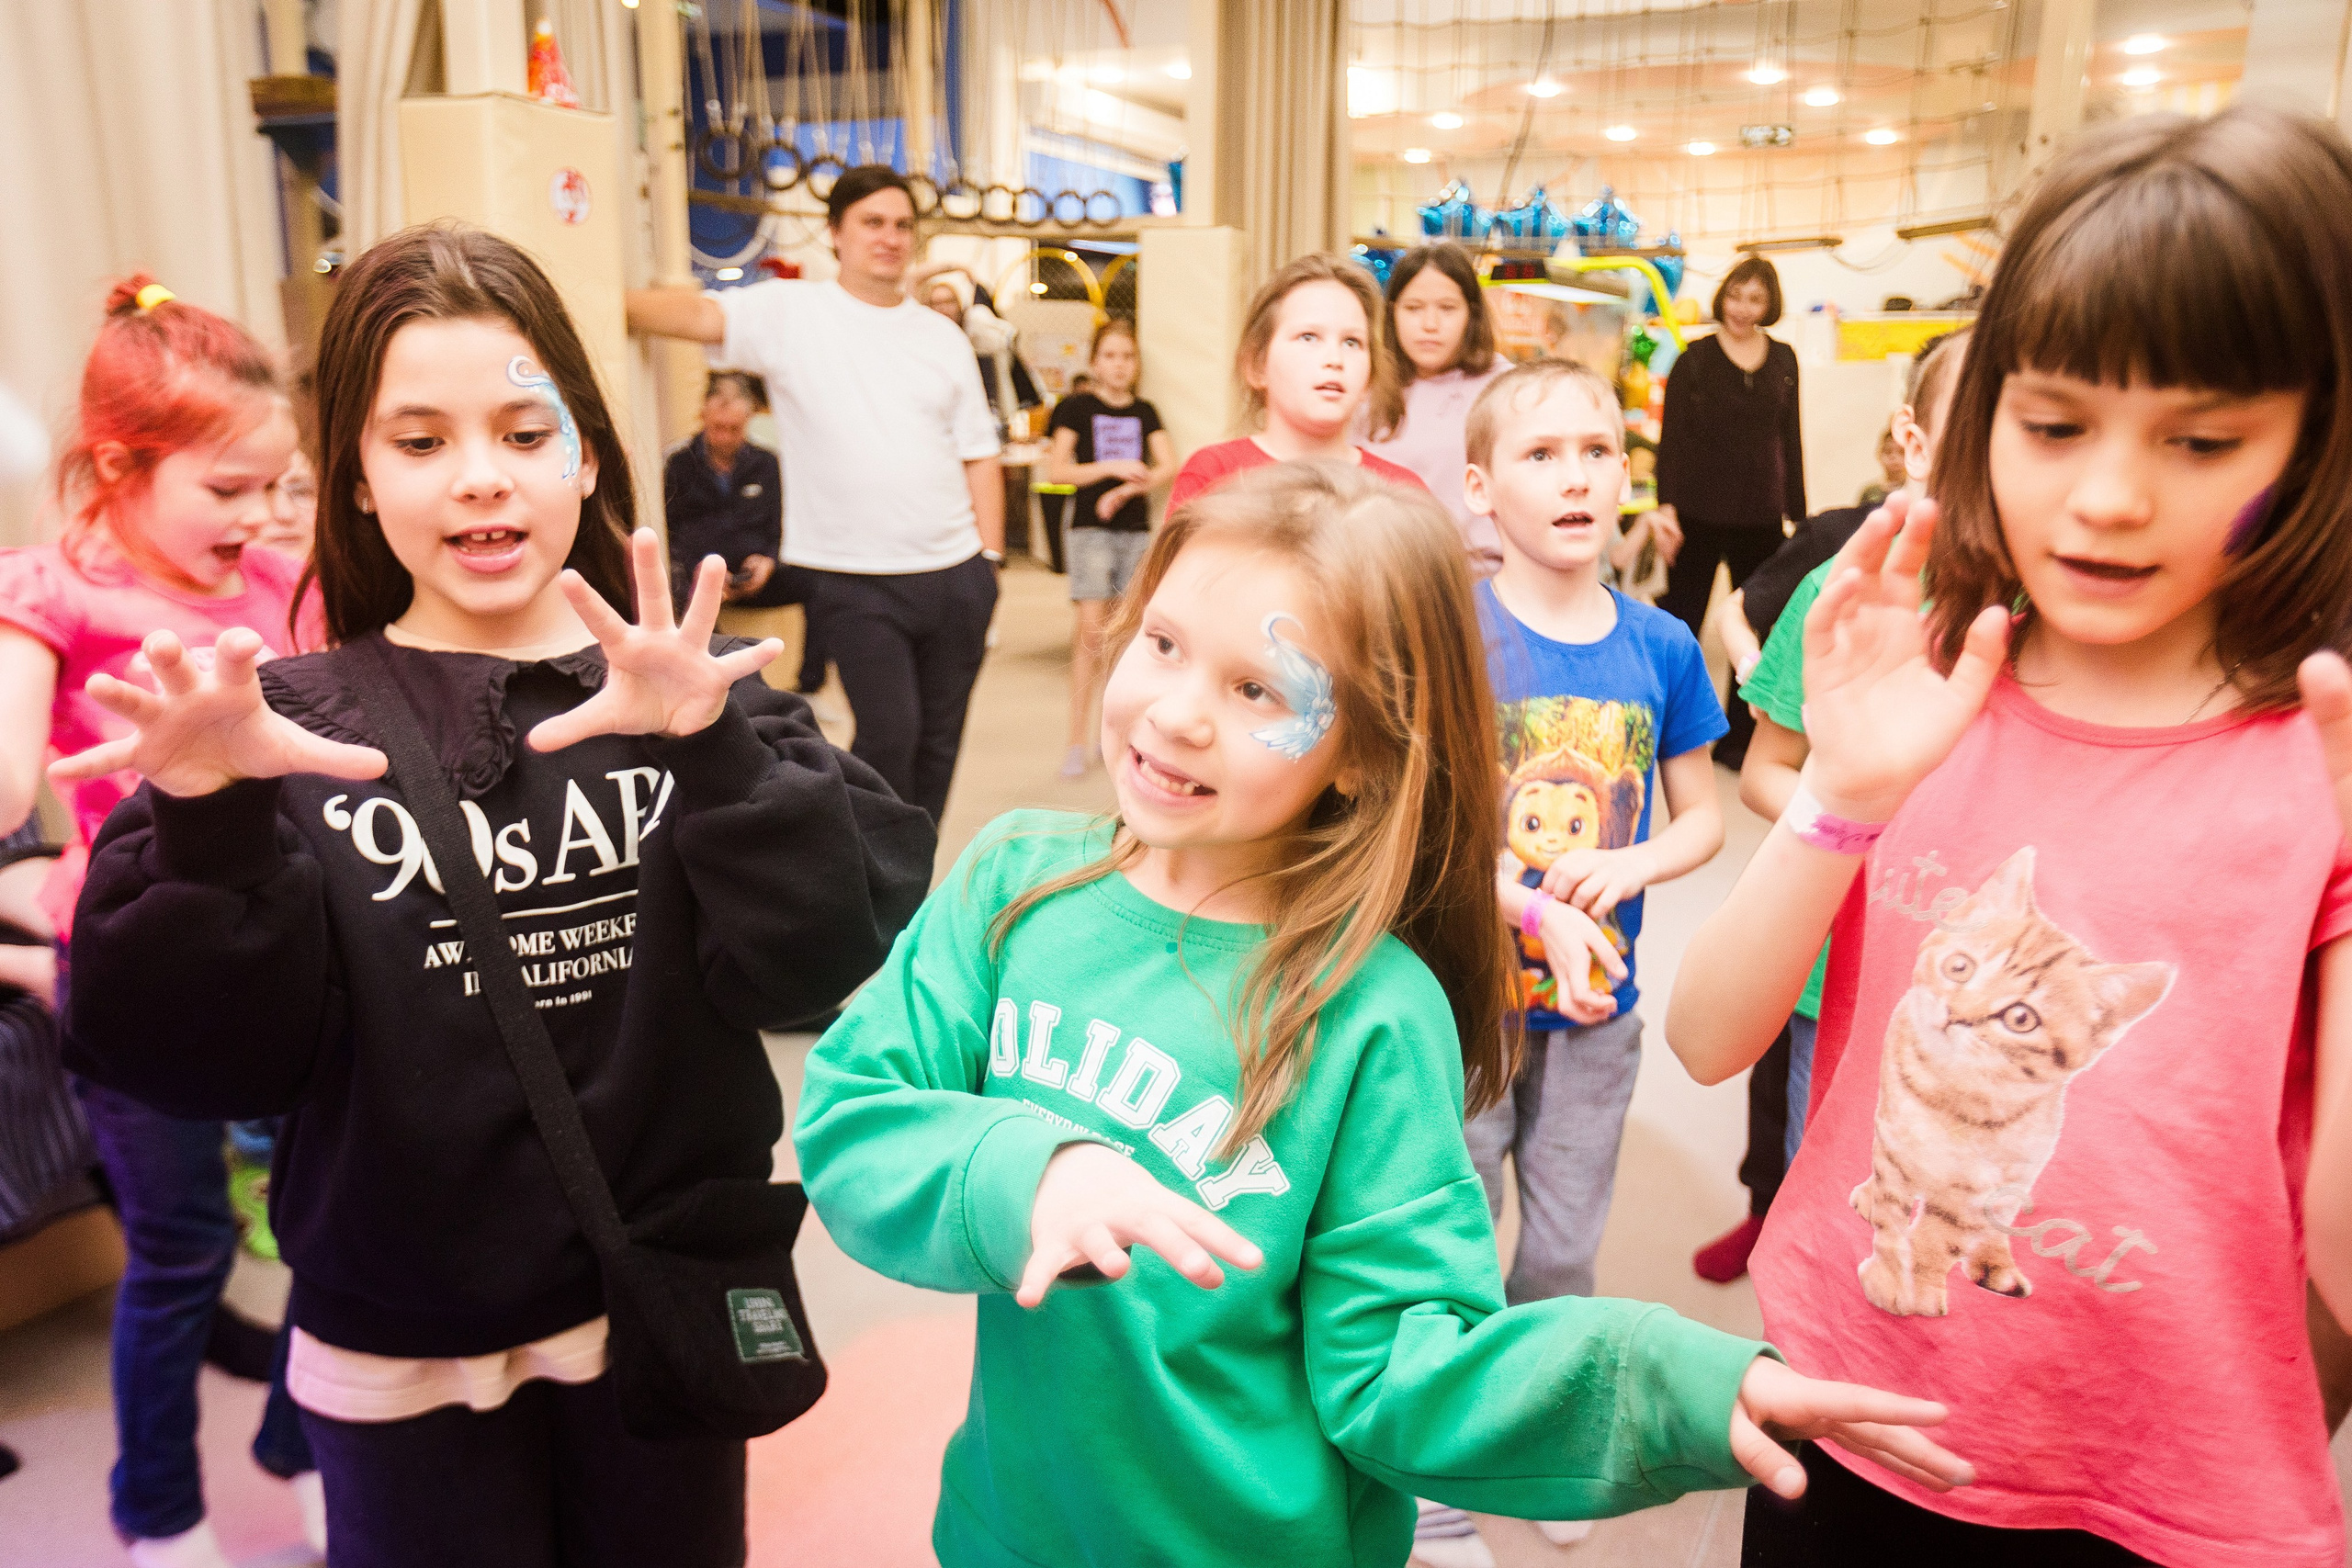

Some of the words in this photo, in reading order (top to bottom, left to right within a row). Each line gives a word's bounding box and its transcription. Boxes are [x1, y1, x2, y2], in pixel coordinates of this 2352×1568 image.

[1867, 850, 1990, 933] ute
[424, 931, 556, 969] AWME
[989, 997, 1291, 1212] OLIDAY
